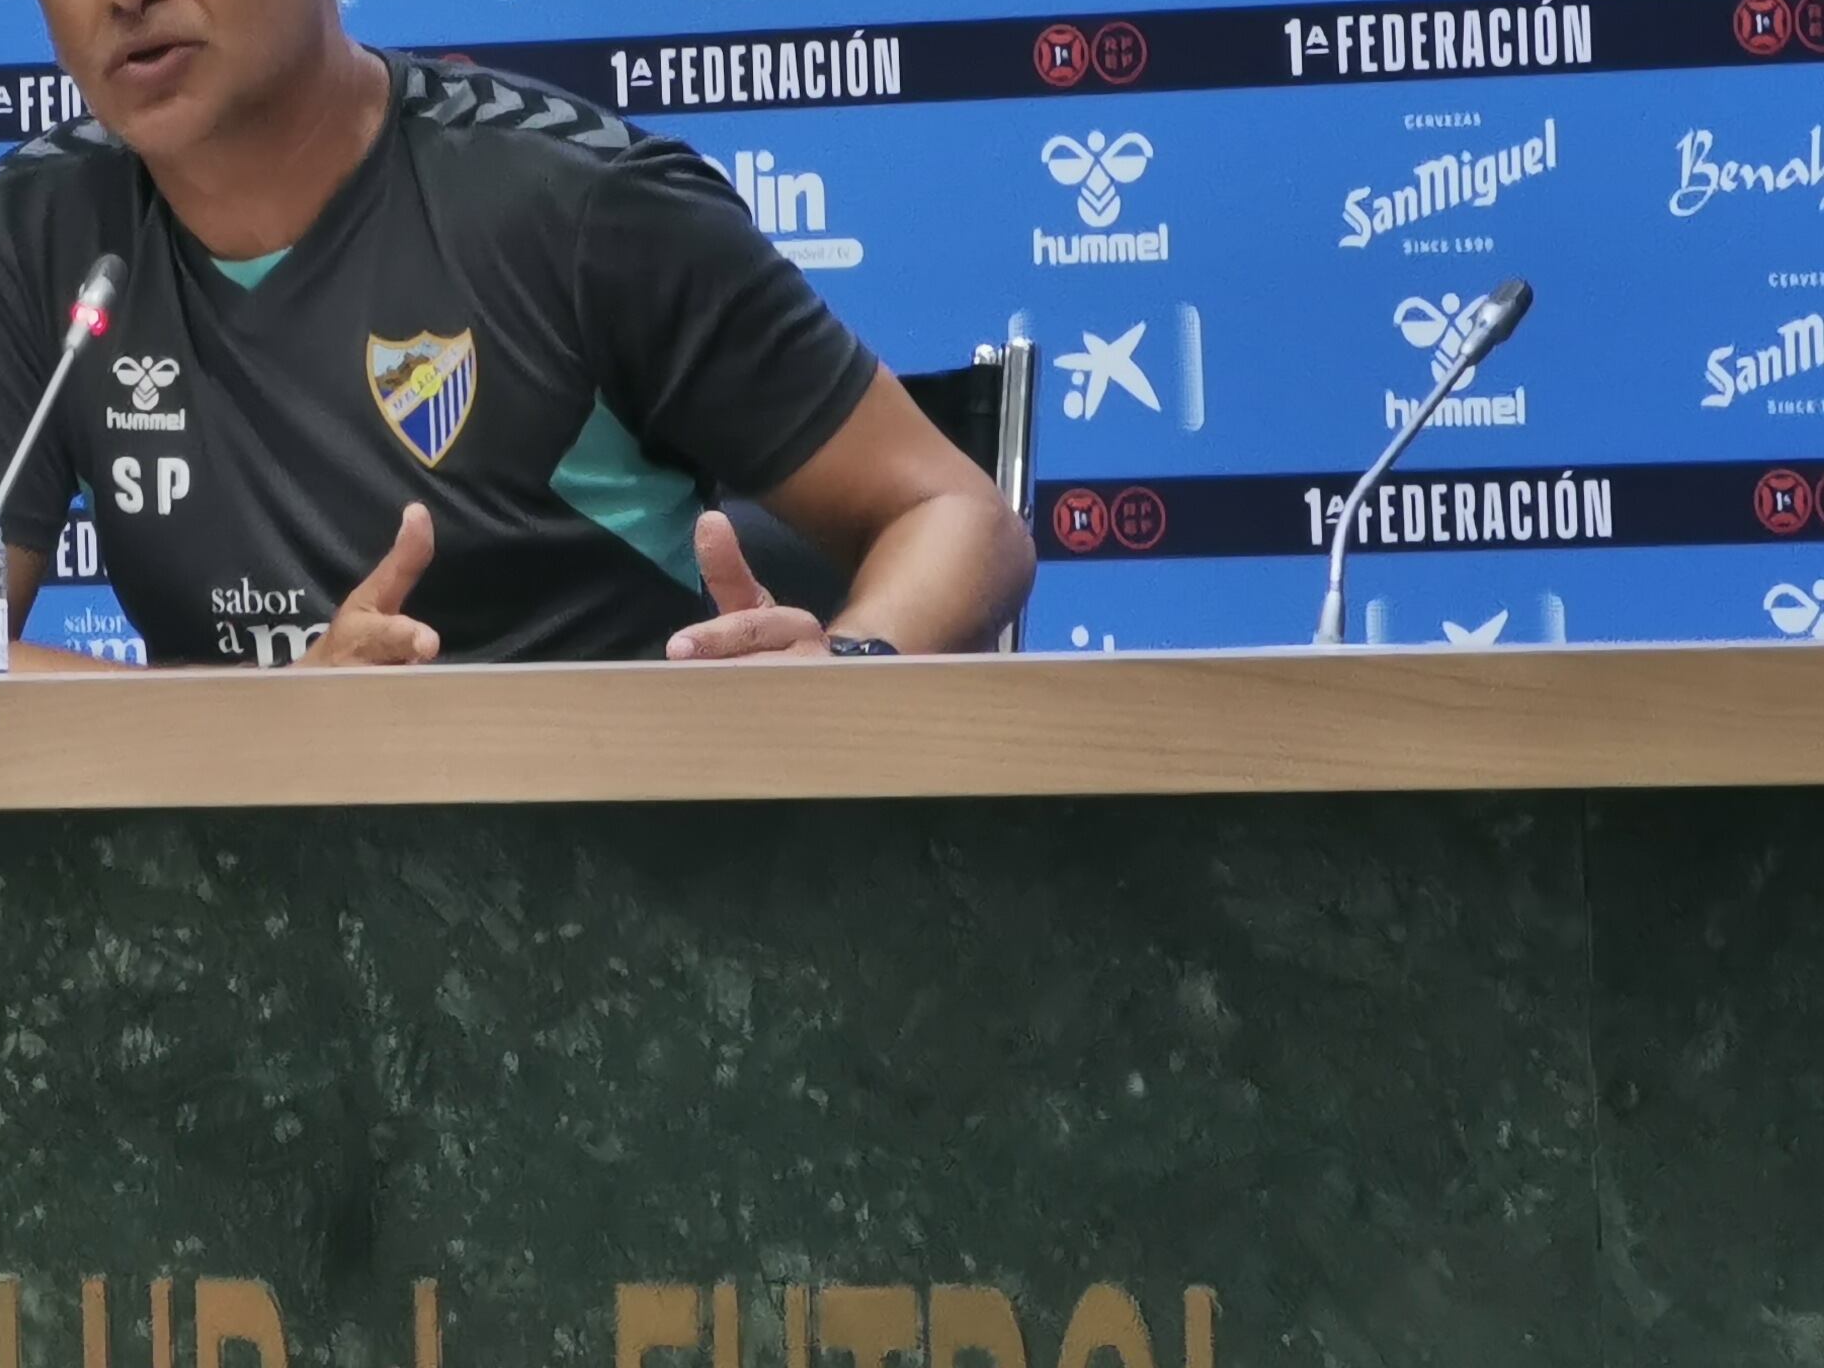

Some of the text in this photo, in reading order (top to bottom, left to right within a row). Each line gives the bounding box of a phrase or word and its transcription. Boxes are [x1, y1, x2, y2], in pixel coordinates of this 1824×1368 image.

[660, 29, 901, 106] FEDERACIÓN
[1033, 223, 1169, 266] hummel
[106, 408, 186, 431] hummel
[210, 577, 306, 616] sabor
